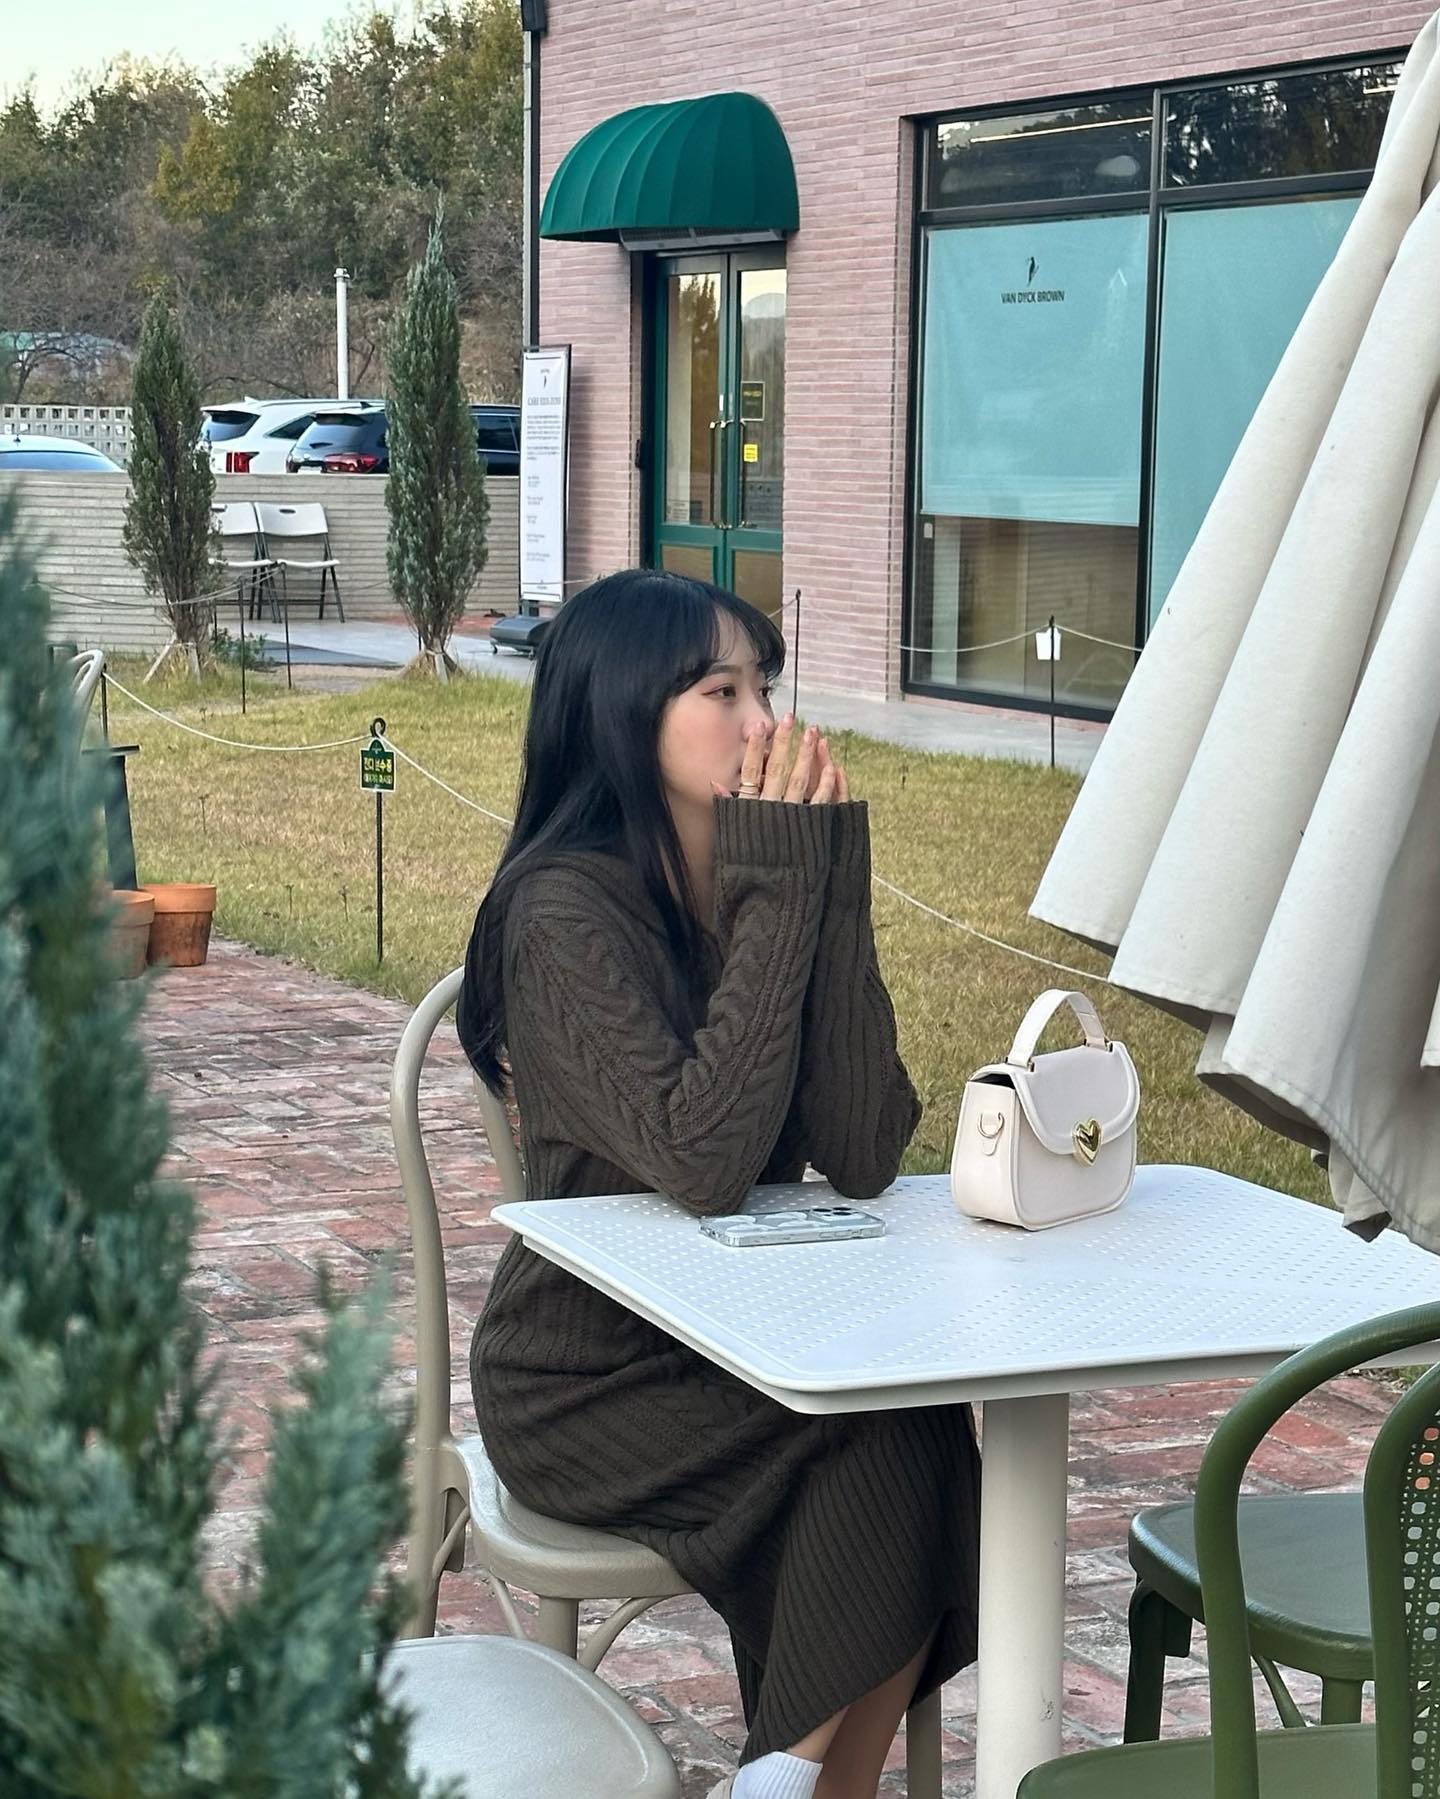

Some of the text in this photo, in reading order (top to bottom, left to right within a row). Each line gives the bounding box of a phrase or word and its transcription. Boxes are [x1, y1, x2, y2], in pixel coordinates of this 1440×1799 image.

[1001, 290, 1065, 304] VAN DYCK BROWN
